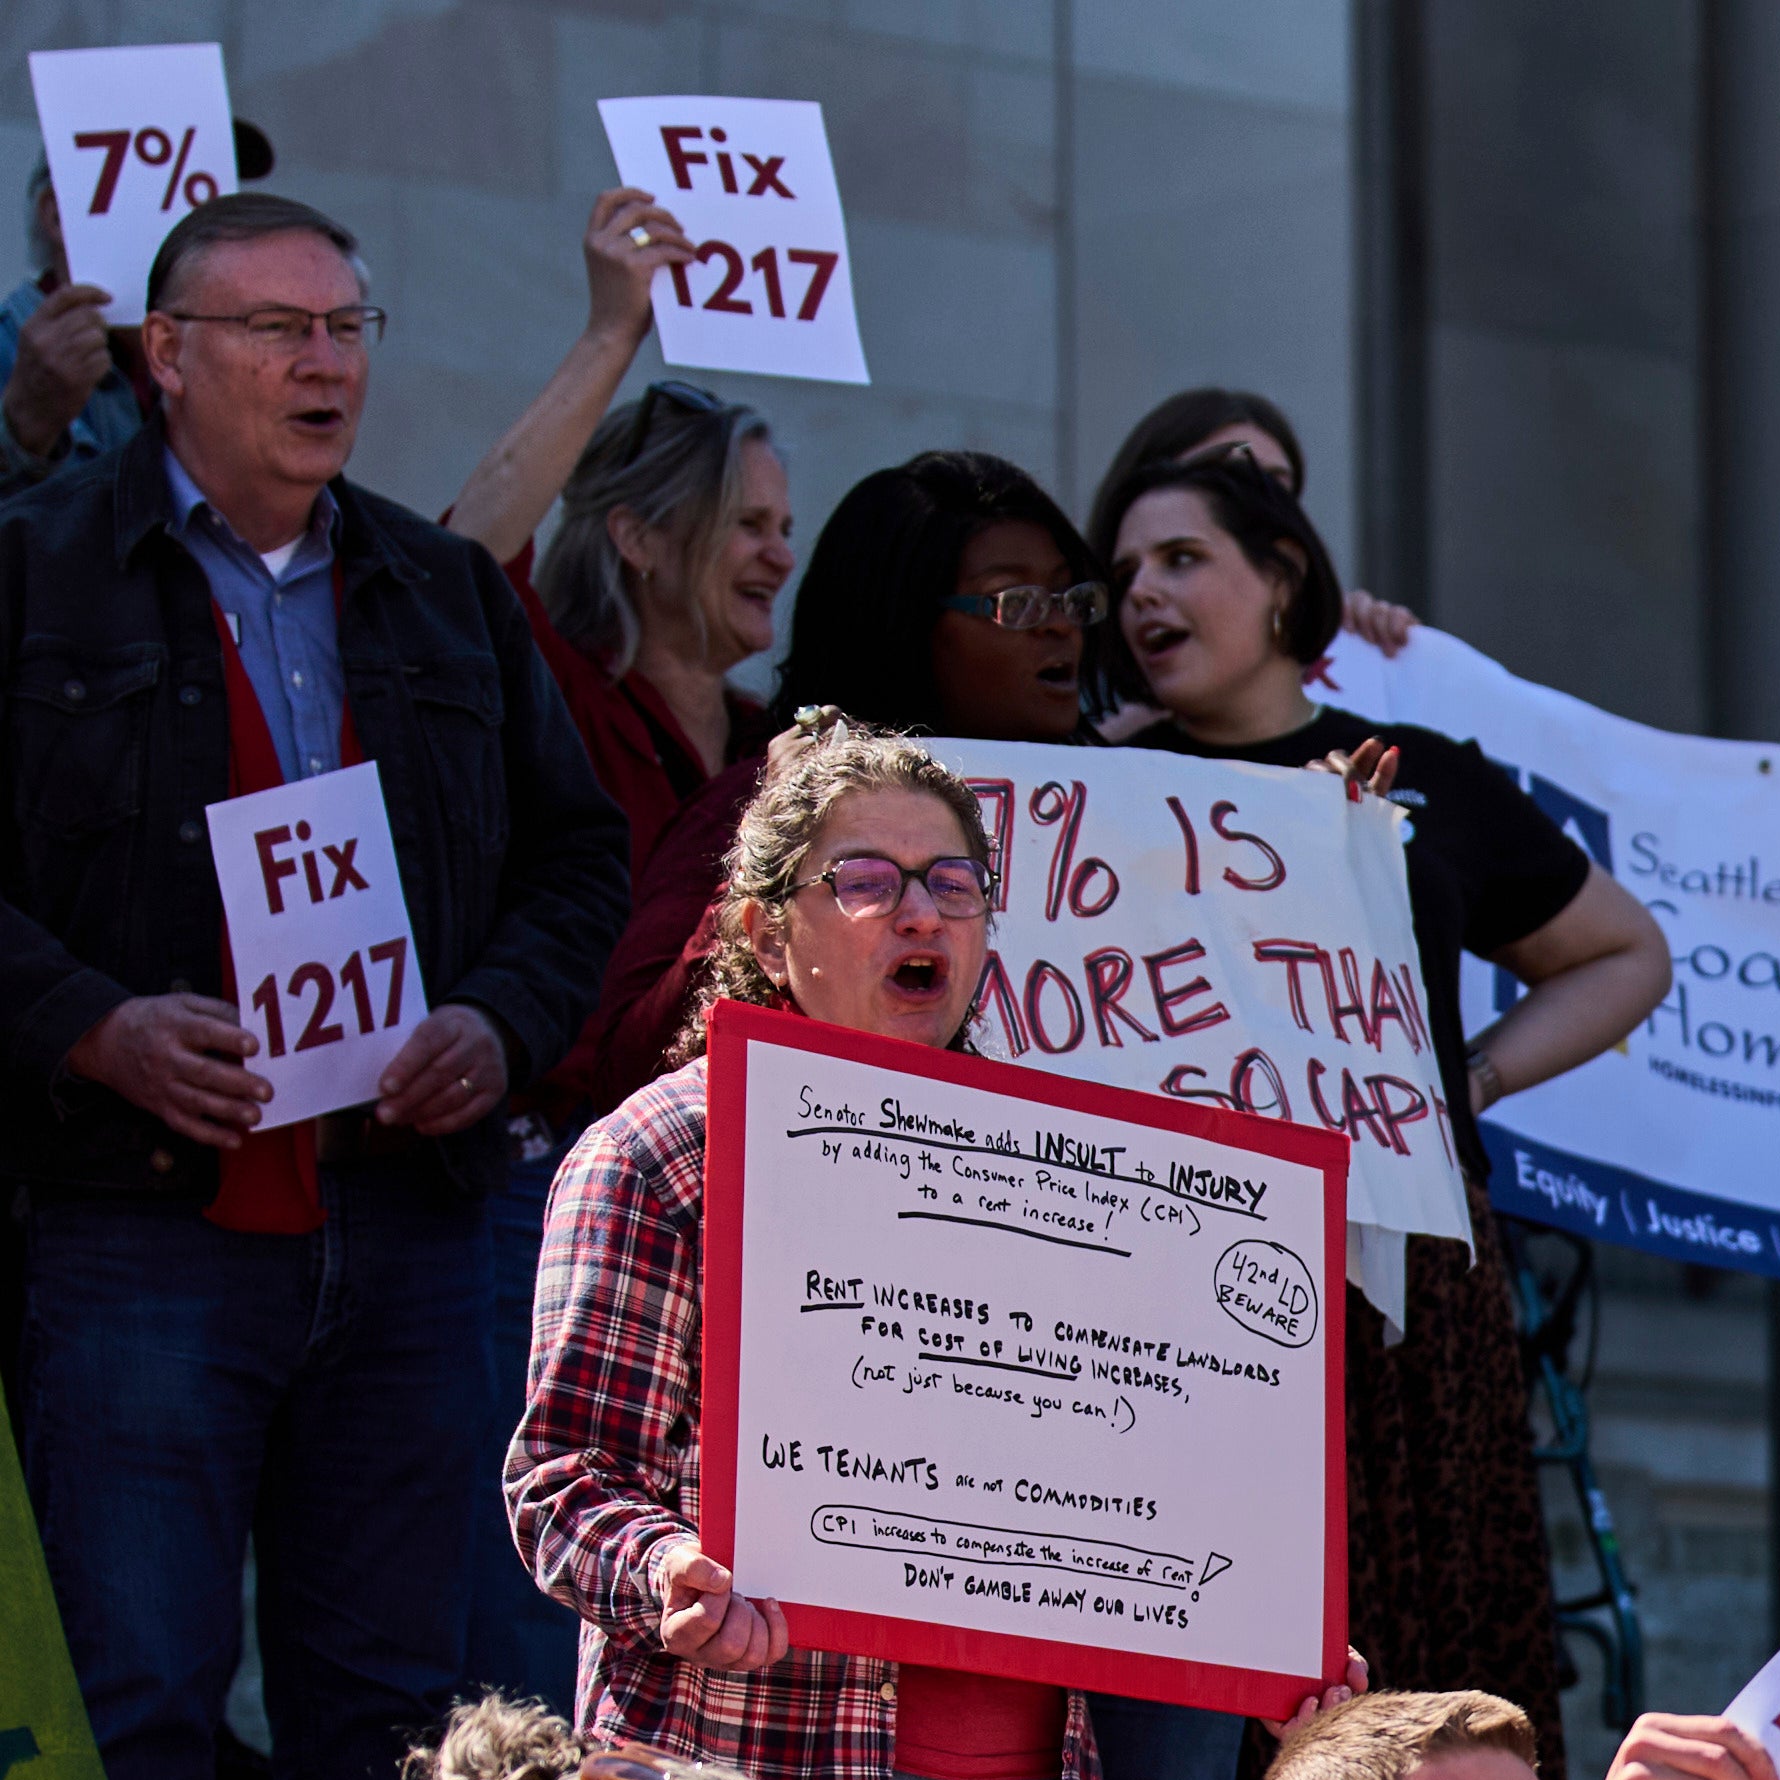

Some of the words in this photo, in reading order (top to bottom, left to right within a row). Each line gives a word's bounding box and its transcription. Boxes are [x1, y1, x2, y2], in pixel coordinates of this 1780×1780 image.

[74, 127, 217, 215] 7%
[659, 126, 796, 200] Fix
[669, 239, 840, 322] 1217
[254, 819, 370, 915] Fix
[966, 779, 1120, 921] 7%
[1166, 796, 1286, 895] IS
[252, 936, 407, 1058] 1217
[798, 1085, 866, 1126] Senator
[879, 1098, 976, 1144] Shewmake
[985, 1130, 1021, 1154] adds
[1035, 1130, 1127, 1177] INSULT
[1135, 1161, 1155, 1182] to
[1169, 1161, 1268, 1212] INJURY
[822, 1140, 841, 1163] by
[852, 1140, 911, 1179] adding
[918, 1151, 942, 1173] the
[952, 1156, 1025, 1188] Consumer
[1035, 1170, 1078, 1199] Price
[1086, 1182, 1129, 1212] Index
[1140, 1197, 1201, 1236] (CPI)
[917, 1184, 939, 1200] to
[952, 1192, 963, 1204] a
[978, 1196, 1012, 1213] rent
[1514, 1149, 1607, 1226] Equity
[1646, 1198, 1763, 1255] Justice
[1216, 1284, 1299, 1337] BEWARE
[1232, 1251, 1279, 1284] 42nd
[1278, 1278, 1309, 1315] LD
[806, 1270, 864, 1300] RENT
[873, 1284, 990, 1325] INCREASES
[1009, 1311, 1034, 1332] TO
[1054, 1321, 1171, 1362] COMPENSATE
[1176, 1347, 1280, 1386] LANDLORDS
[861, 1316, 904, 1341] FOR
[918, 1328, 965, 1352] COST
[979, 1340, 1003, 1358] OF
[1018, 1345, 1082, 1374] LIVING
[1091, 1359, 1190, 1404] INCREASES,
[851, 1355, 896, 1389] (not
[902, 1367, 943, 1394] just
[952, 1373, 1025, 1405] because
[1030, 1394, 1062, 1418] you
[762, 1433, 804, 1472] WE
[816, 1445, 940, 1491] TENANTS
[955, 1474, 975, 1488] are
[1015, 1478, 1157, 1521] COMMODITIES
[823, 1514, 856, 1535] CPI
[873, 1518, 927, 1543] increases
[930, 1527, 947, 1545] to
[1040, 1544, 1062, 1563] the
[1072, 1548, 1130, 1575] increase
[1137, 1559, 1153, 1577] of
[1162, 1565, 1194, 1584] rent
[904, 1562, 954, 1591] DON'T
[964, 1575, 1032, 1603] GAMBLE
[1038, 1587, 1087, 1613] AWAY
[1094, 1599, 1124, 1616] OUR
[1134, 1603, 1189, 1630] LIVES
